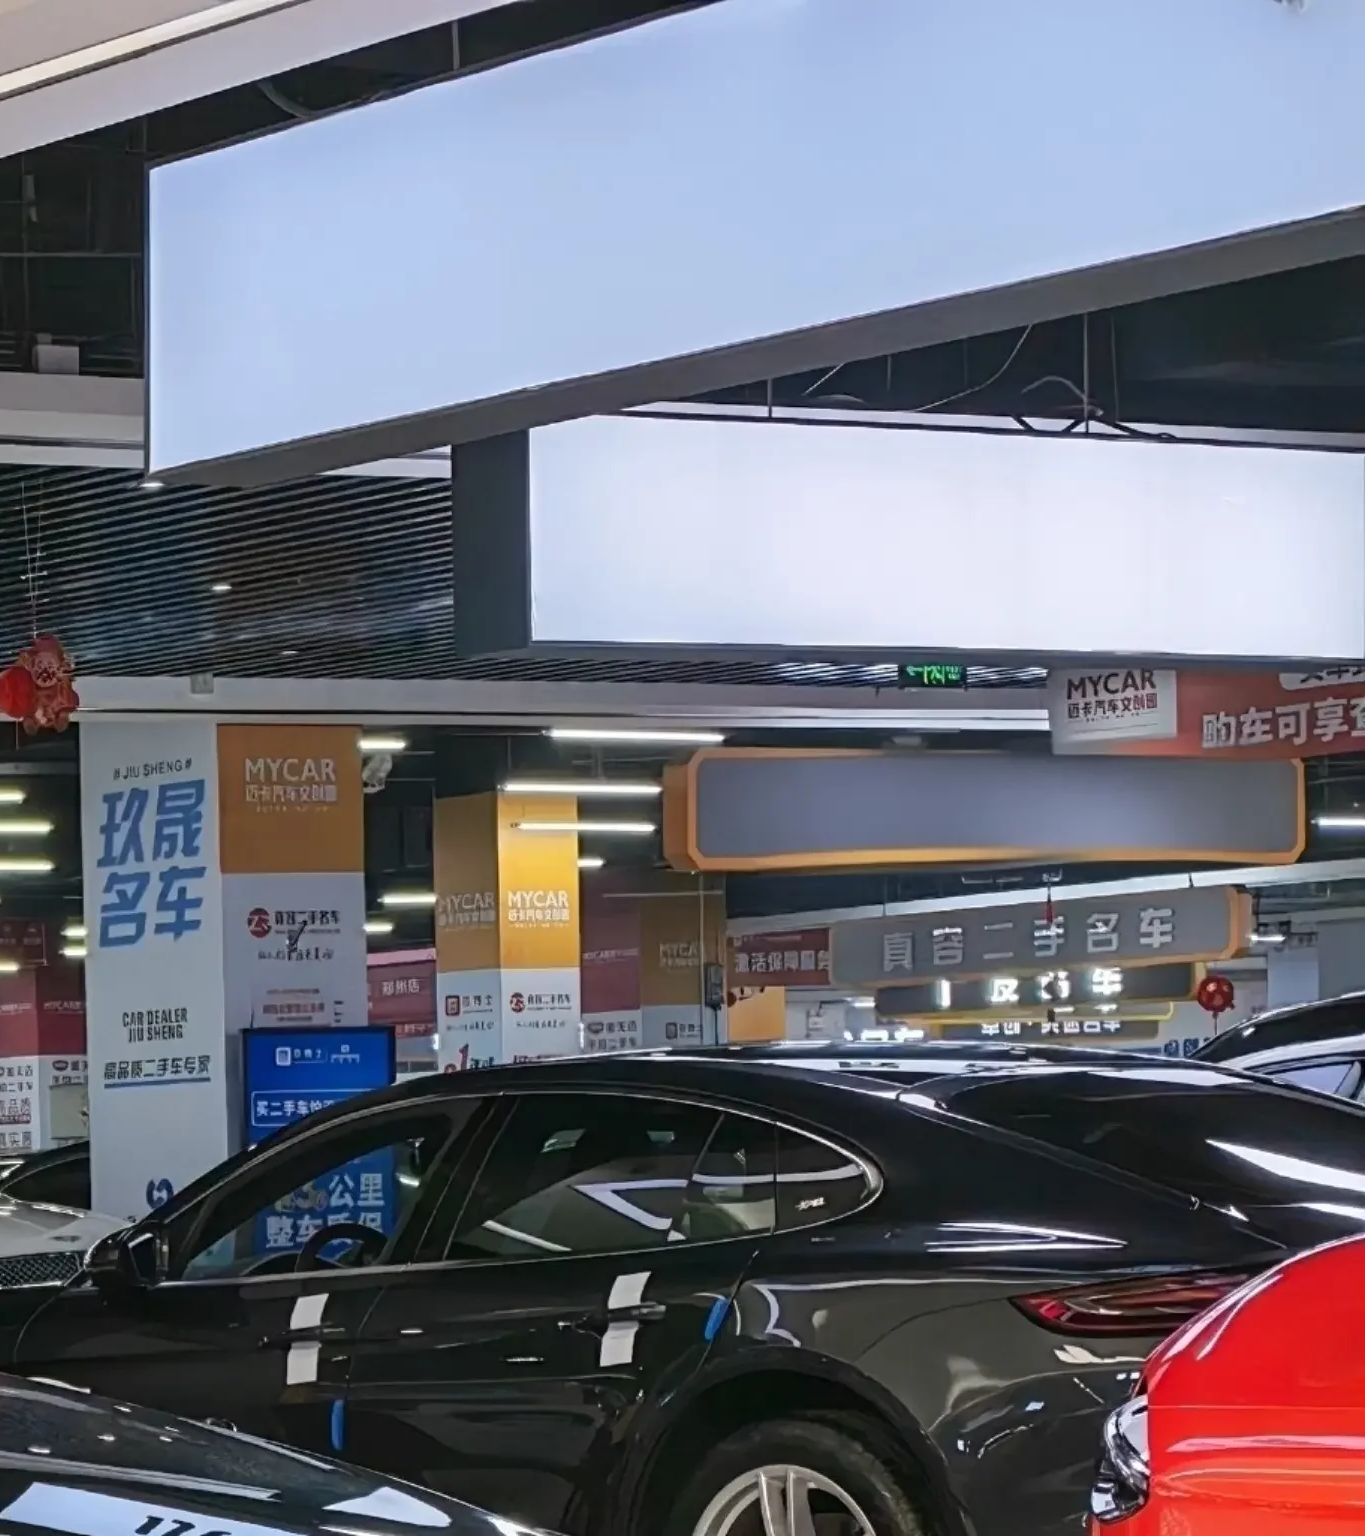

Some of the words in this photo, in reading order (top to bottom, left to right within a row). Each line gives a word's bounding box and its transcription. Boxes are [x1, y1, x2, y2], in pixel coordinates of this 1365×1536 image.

[1066, 668, 1157, 700] MYCAR
[143, 760, 183, 777] SHENG
[245, 758, 336, 782] MYCAR
[99, 866, 207, 948] 名车
[508, 890, 569, 908] MYCAR
[122, 1011, 144, 1027] CAR
[147, 1007, 188, 1025] DEALER
[129, 1027, 144, 1043] JIU
[147, 1024, 183, 1041] SHENG
